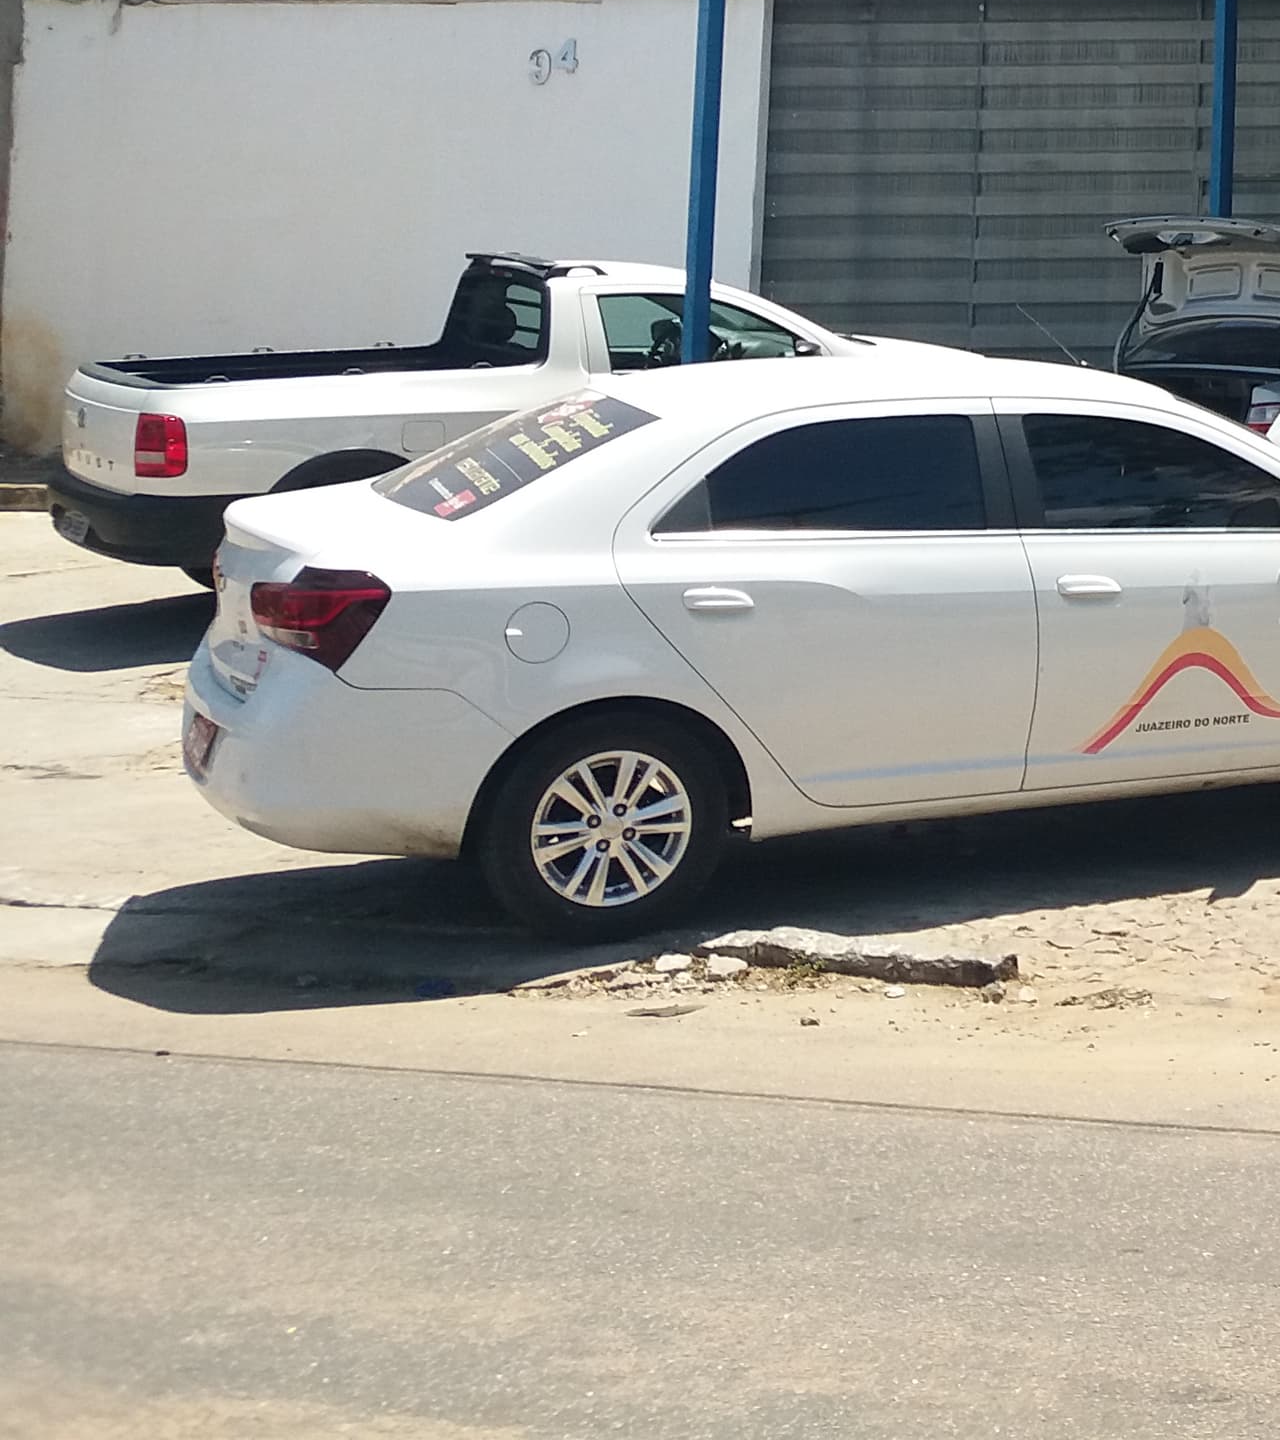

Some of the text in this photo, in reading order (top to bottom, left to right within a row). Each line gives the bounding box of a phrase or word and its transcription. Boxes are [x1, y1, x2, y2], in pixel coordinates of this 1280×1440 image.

[1136, 714, 1250, 732] JUAZEIRO DO NORTE
